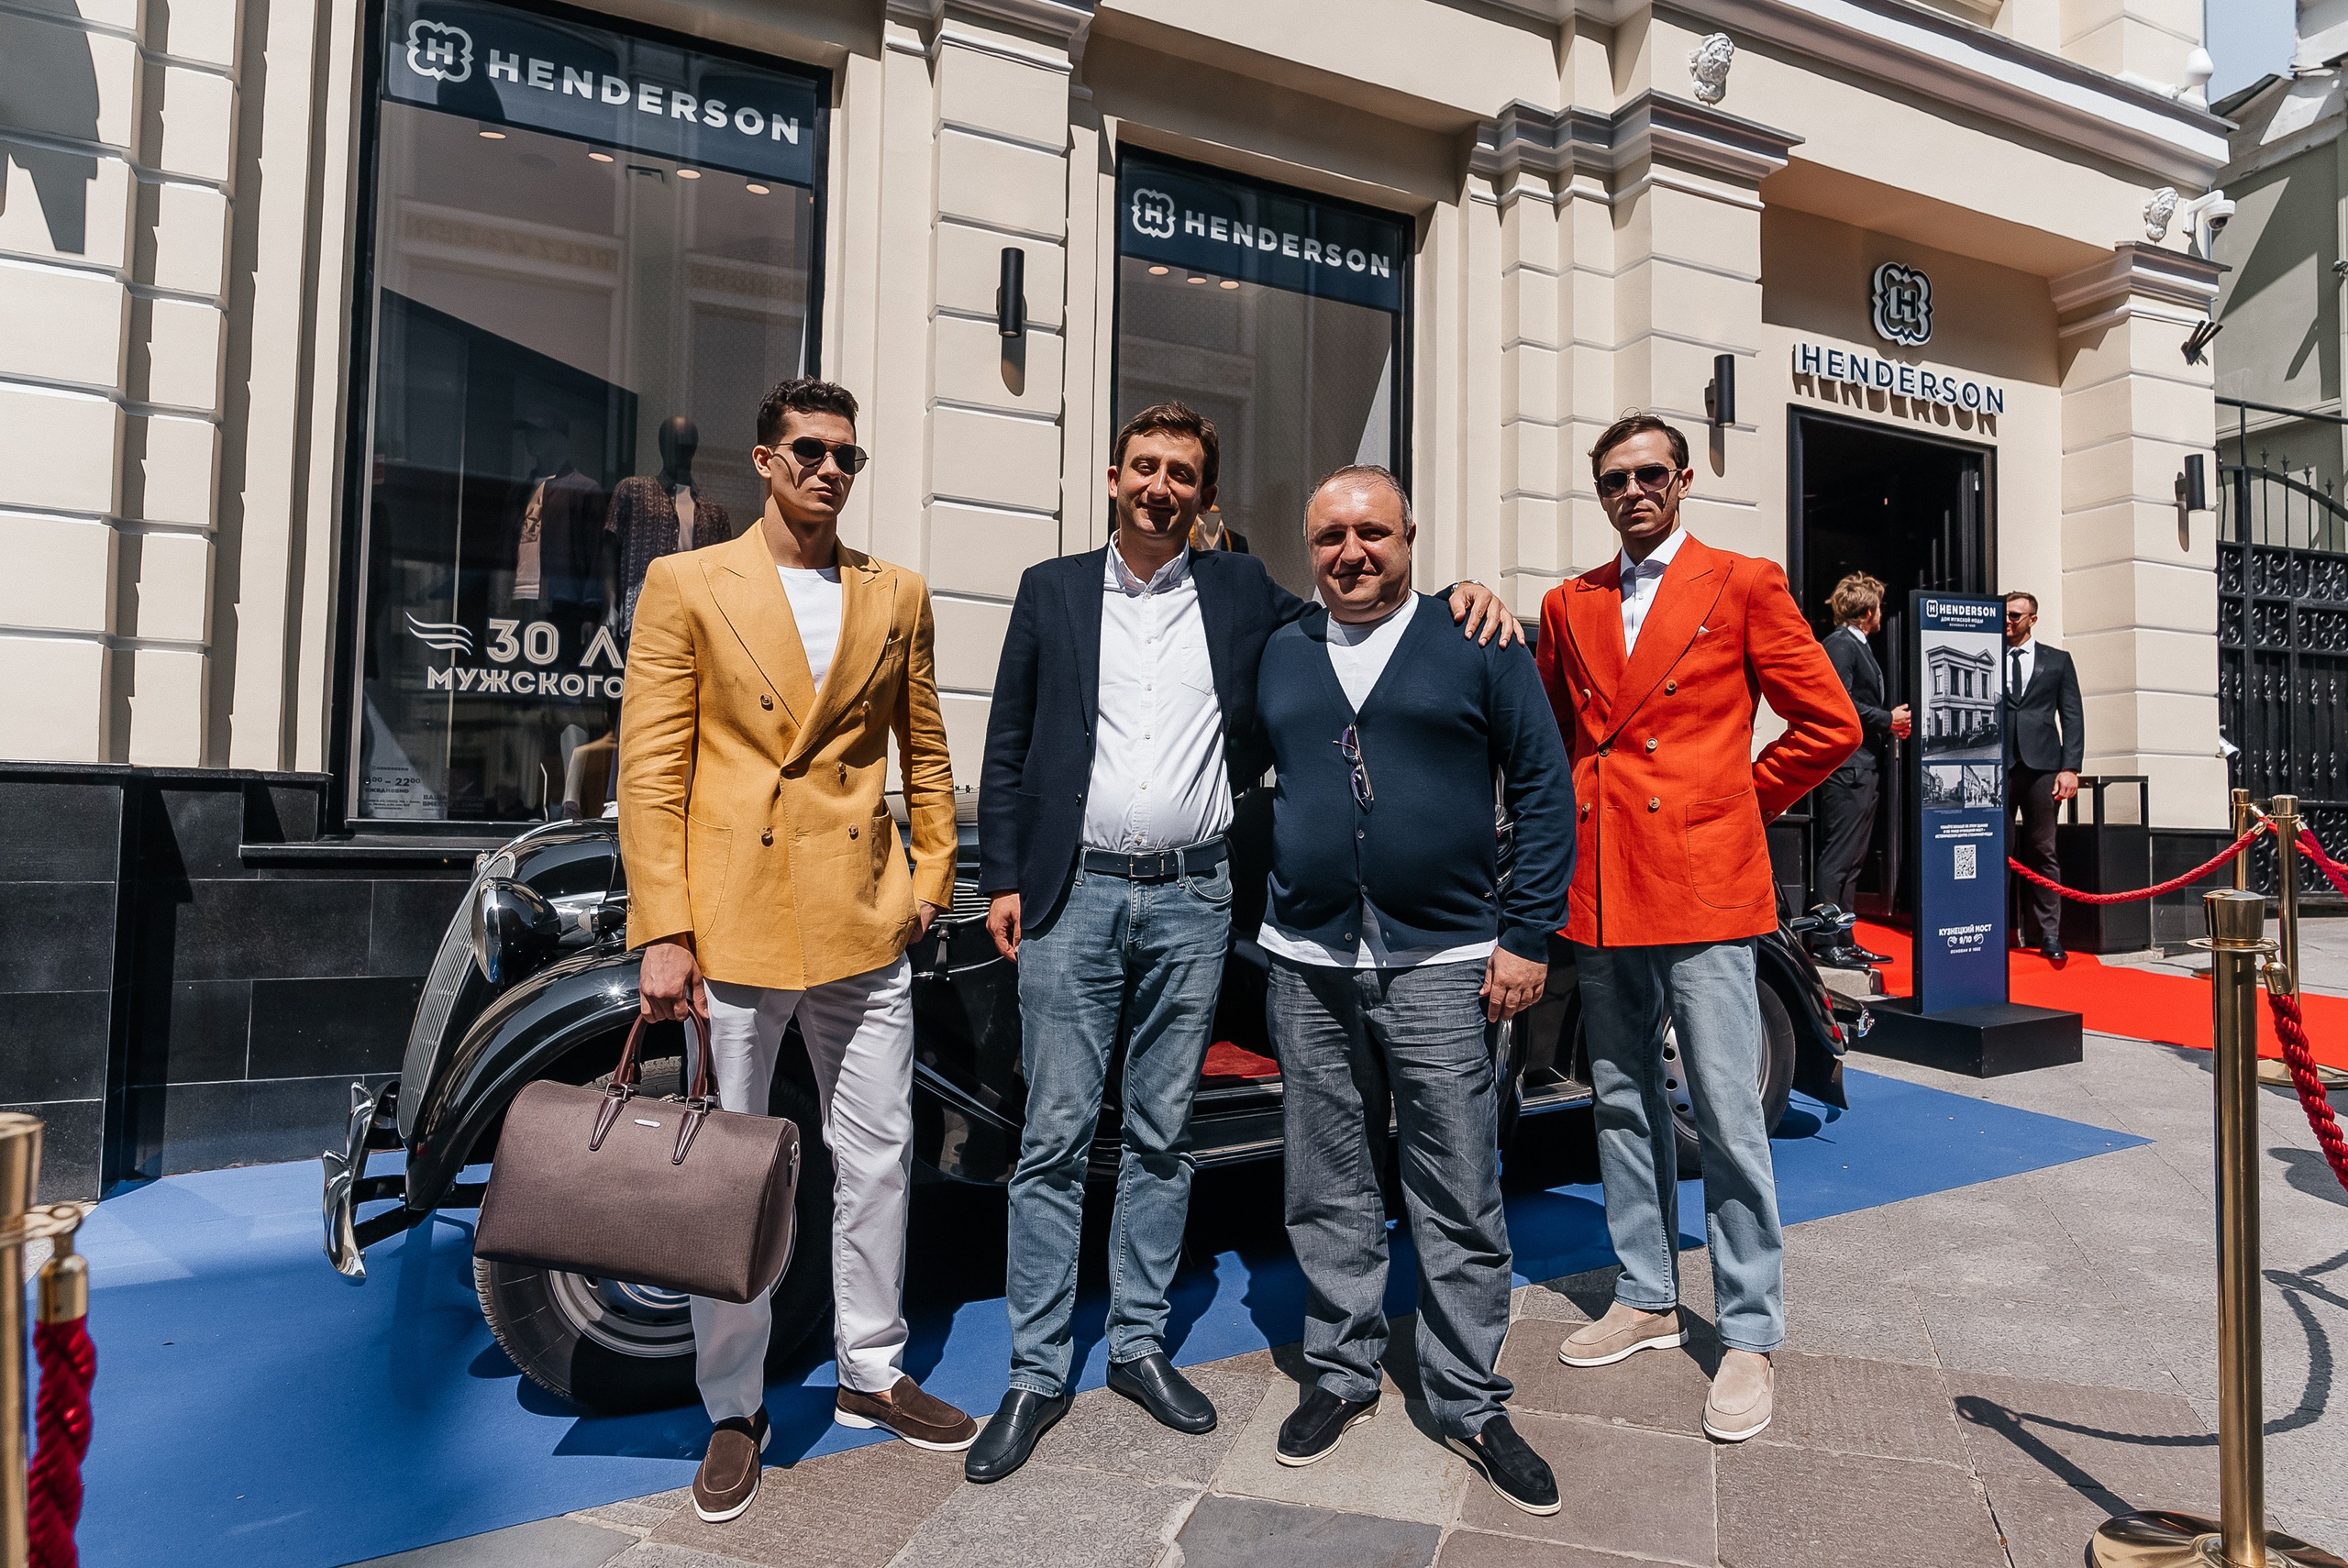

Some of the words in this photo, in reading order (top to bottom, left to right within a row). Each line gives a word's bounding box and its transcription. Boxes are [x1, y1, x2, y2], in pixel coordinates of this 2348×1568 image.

[489, 49, 800, 145] HENDERSON
[1185, 209, 1390, 278] HENDERSON
[1795, 343, 2004, 415] HENDERSON
[1939, 603, 1996, 617] HENDERSON
[486, 618, 559, 666] 30
[427, 666, 624, 699] МУЖСКОГО
[1939, 924, 1974, 936] КУЗНЕЦКИЙ
[1975, 923, 1992, 933] МОСТ
[1959, 935, 1972, 944] 9/10
